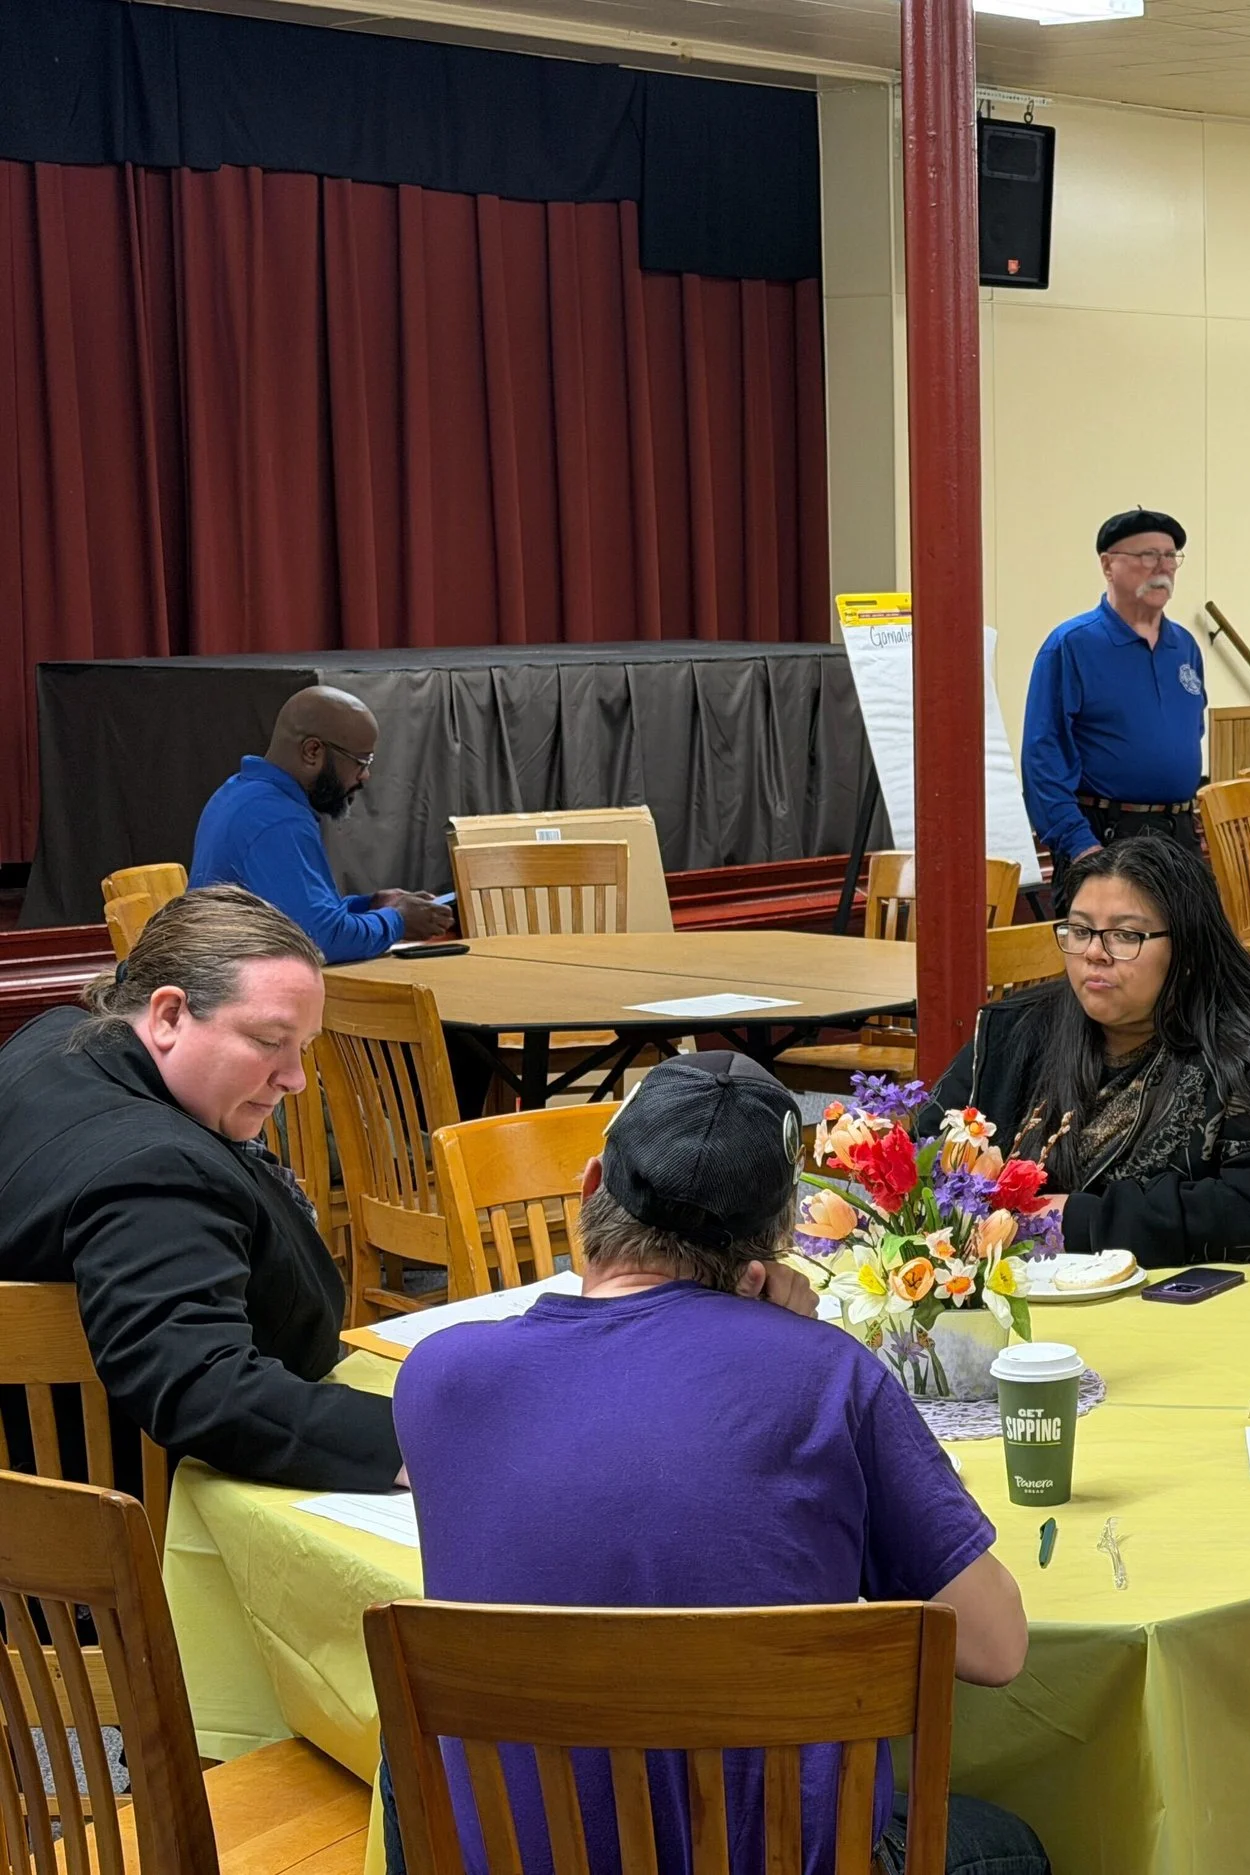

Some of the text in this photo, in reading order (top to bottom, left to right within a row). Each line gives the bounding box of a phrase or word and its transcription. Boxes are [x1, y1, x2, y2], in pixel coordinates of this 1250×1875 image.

[1018, 1408, 1044, 1418] GET
[1005, 1416, 1062, 1442] SIPPING
[1014, 1475, 1053, 1488] Panera
